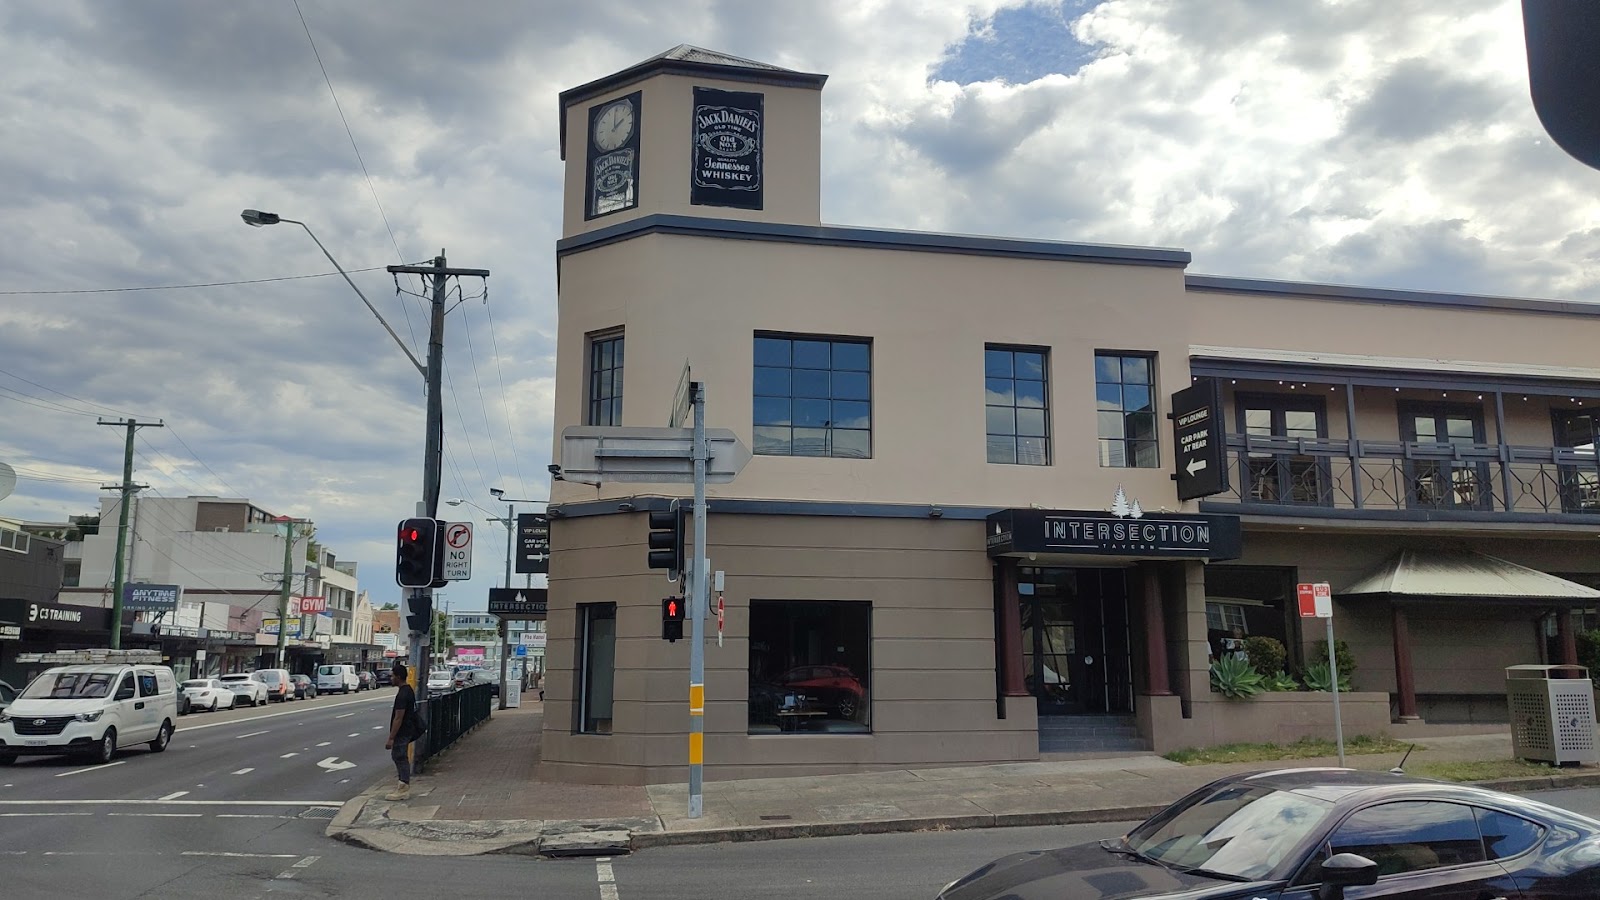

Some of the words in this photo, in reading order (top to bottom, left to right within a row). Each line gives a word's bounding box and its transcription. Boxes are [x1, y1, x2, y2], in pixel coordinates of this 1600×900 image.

[699, 113, 721, 129] JACK
[721, 110, 756, 132] DANIEL'S
[704, 157, 750, 171] Tennessee
[702, 170, 753, 181] WHISKEY
[1187, 410, 1208, 423] LOUNGE
[1181, 434, 1193, 444] CAR
[1193, 429, 1208, 441] PARK
[1184, 444, 1191, 453] AT
[1191, 440, 1207, 451] REAR
[1044, 520, 1211, 543] INTERSECTION
[450, 551, 465, 560] NO
[132, 589, 176, 597] ANYTIME
[302, 598, 324, 611] GYM
[40, 608, 49, 620] C3
[50, 609, 81, 622] TRAINING
[264, 624, 298, 632] CHEIST
